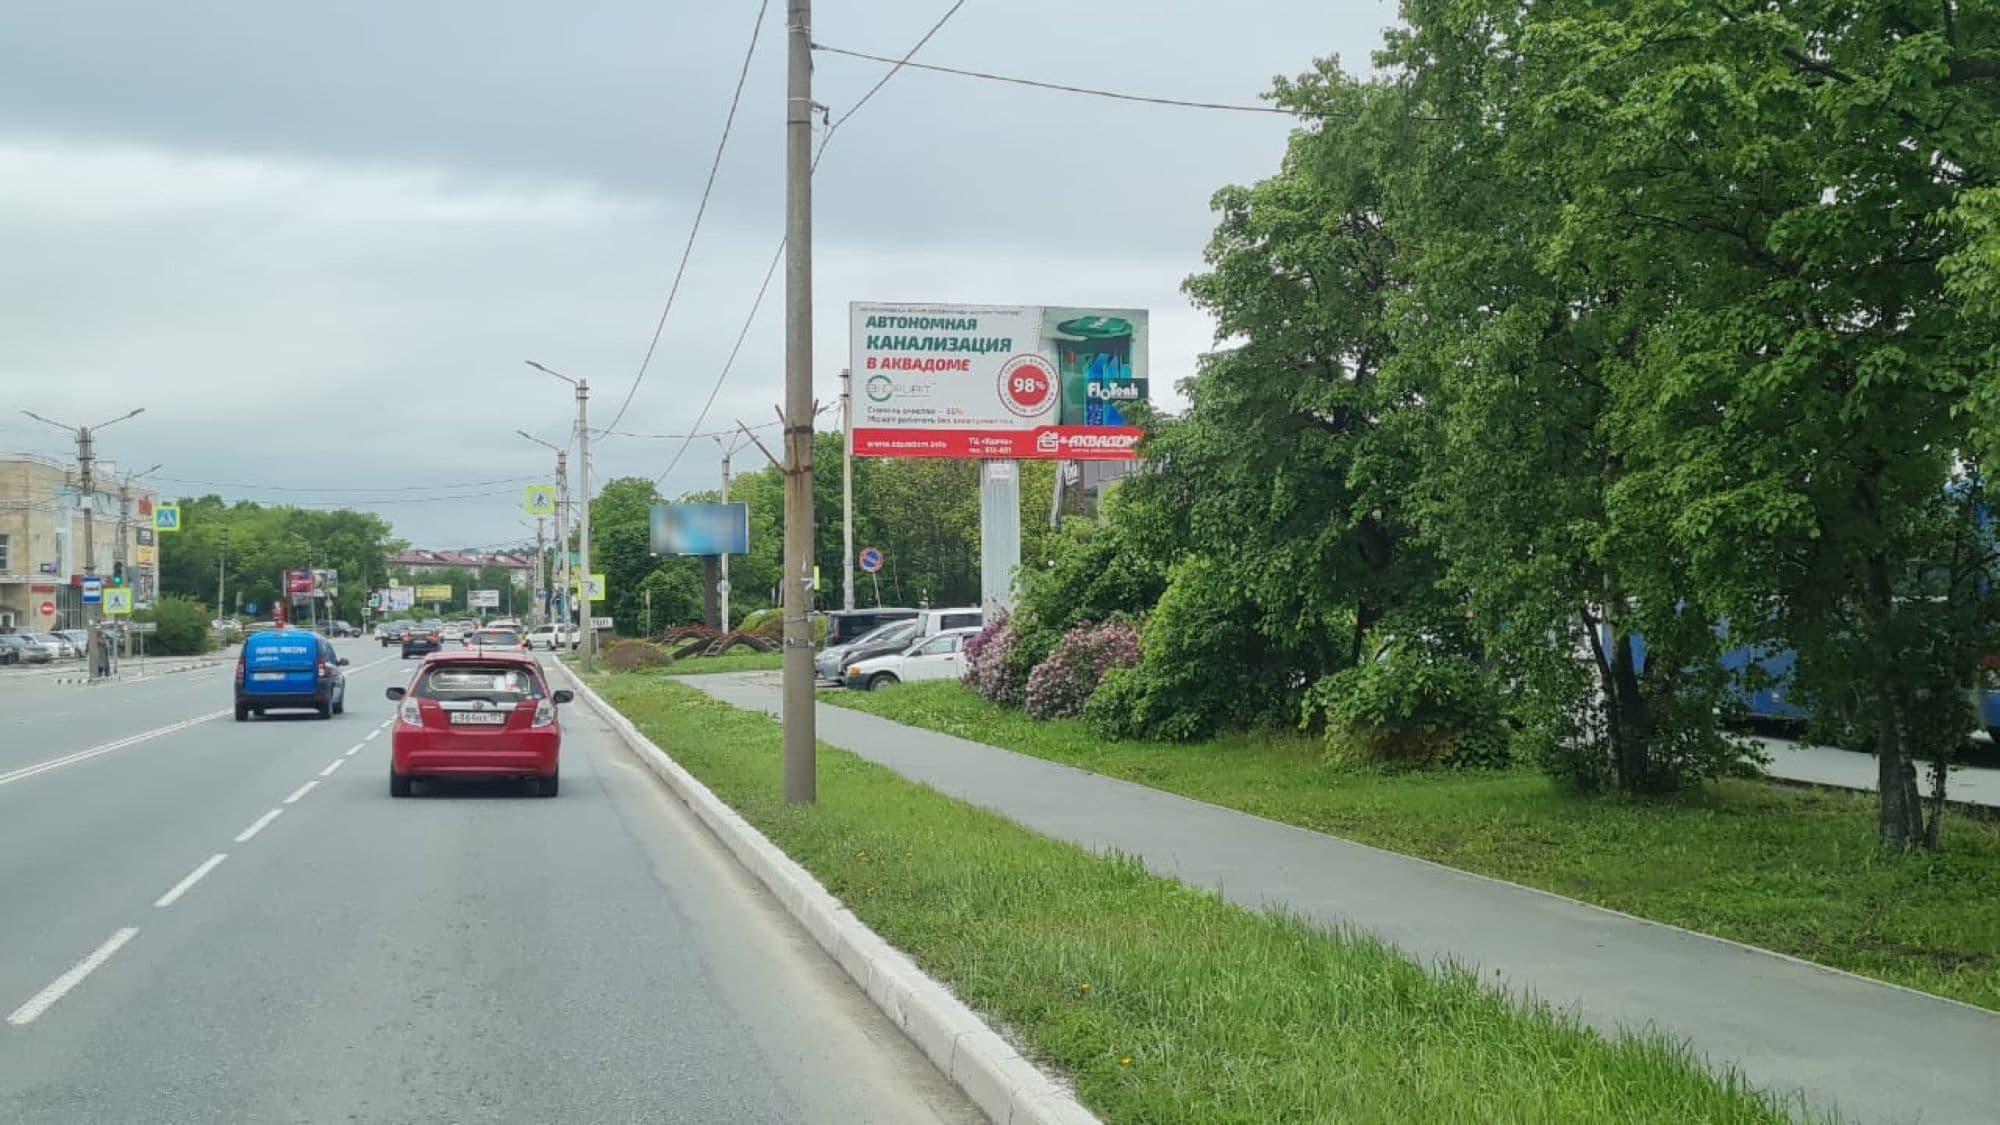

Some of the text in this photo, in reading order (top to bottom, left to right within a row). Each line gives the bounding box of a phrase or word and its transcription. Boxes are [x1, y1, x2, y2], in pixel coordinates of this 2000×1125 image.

[866, 315, 977, 331] АВТОНОМНАЯ
[866, 335, 1013, 355] КАНАЛИЗАЦИЯ
[866, 357, 972, 373] В АКВАДОМЕ
[1013, 377, 1046, 393] 98%
